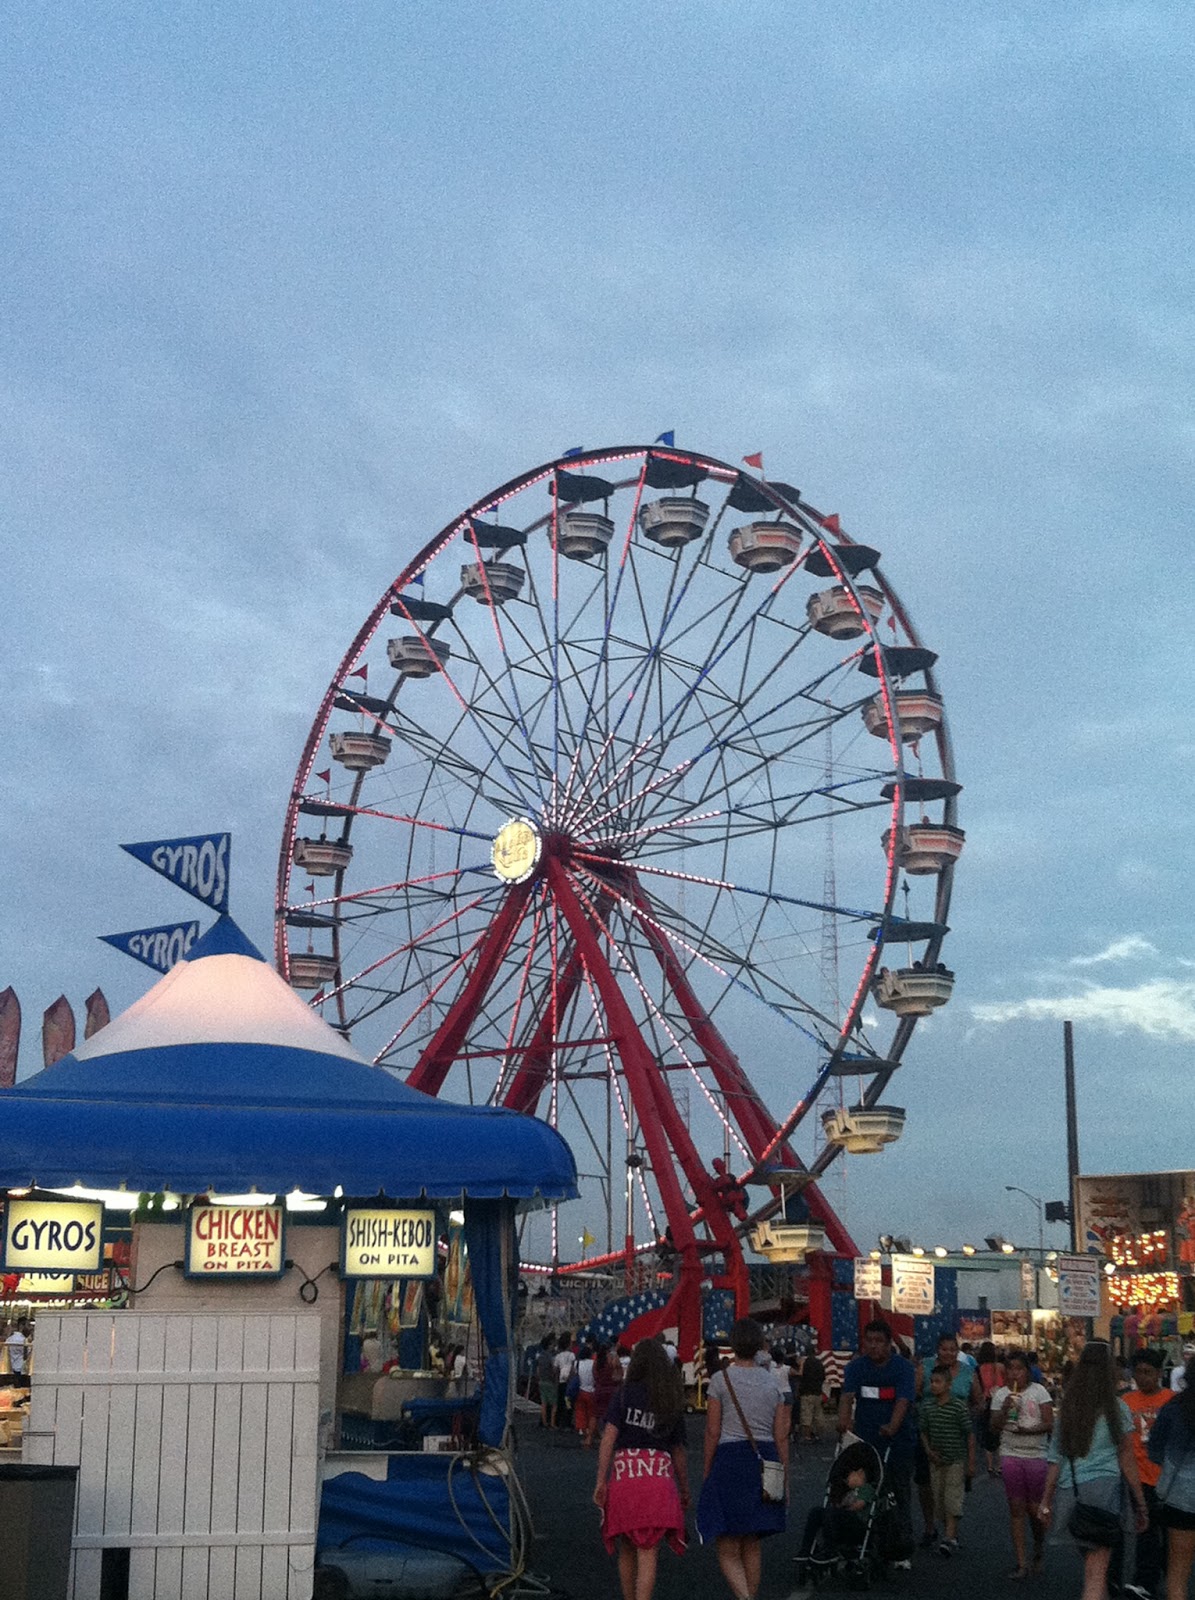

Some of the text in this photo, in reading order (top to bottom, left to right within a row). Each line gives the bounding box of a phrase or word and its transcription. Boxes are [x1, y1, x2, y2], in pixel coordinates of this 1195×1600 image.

[151, 834, 227, 906] GYROS
[11, 1219, 96, 1252] GYROS
[195, 1209, 279, 1240] CHICKEN
[349, 1218, 432, 1248] SHISH-KEBOB
[207, 1242, 274, 1257] BREAST
[359, 1254, 419, 1265] ON PITA
[203, 1261, 273, 1270] ON PITA
[614, 1457, 672, 1481] PINK
